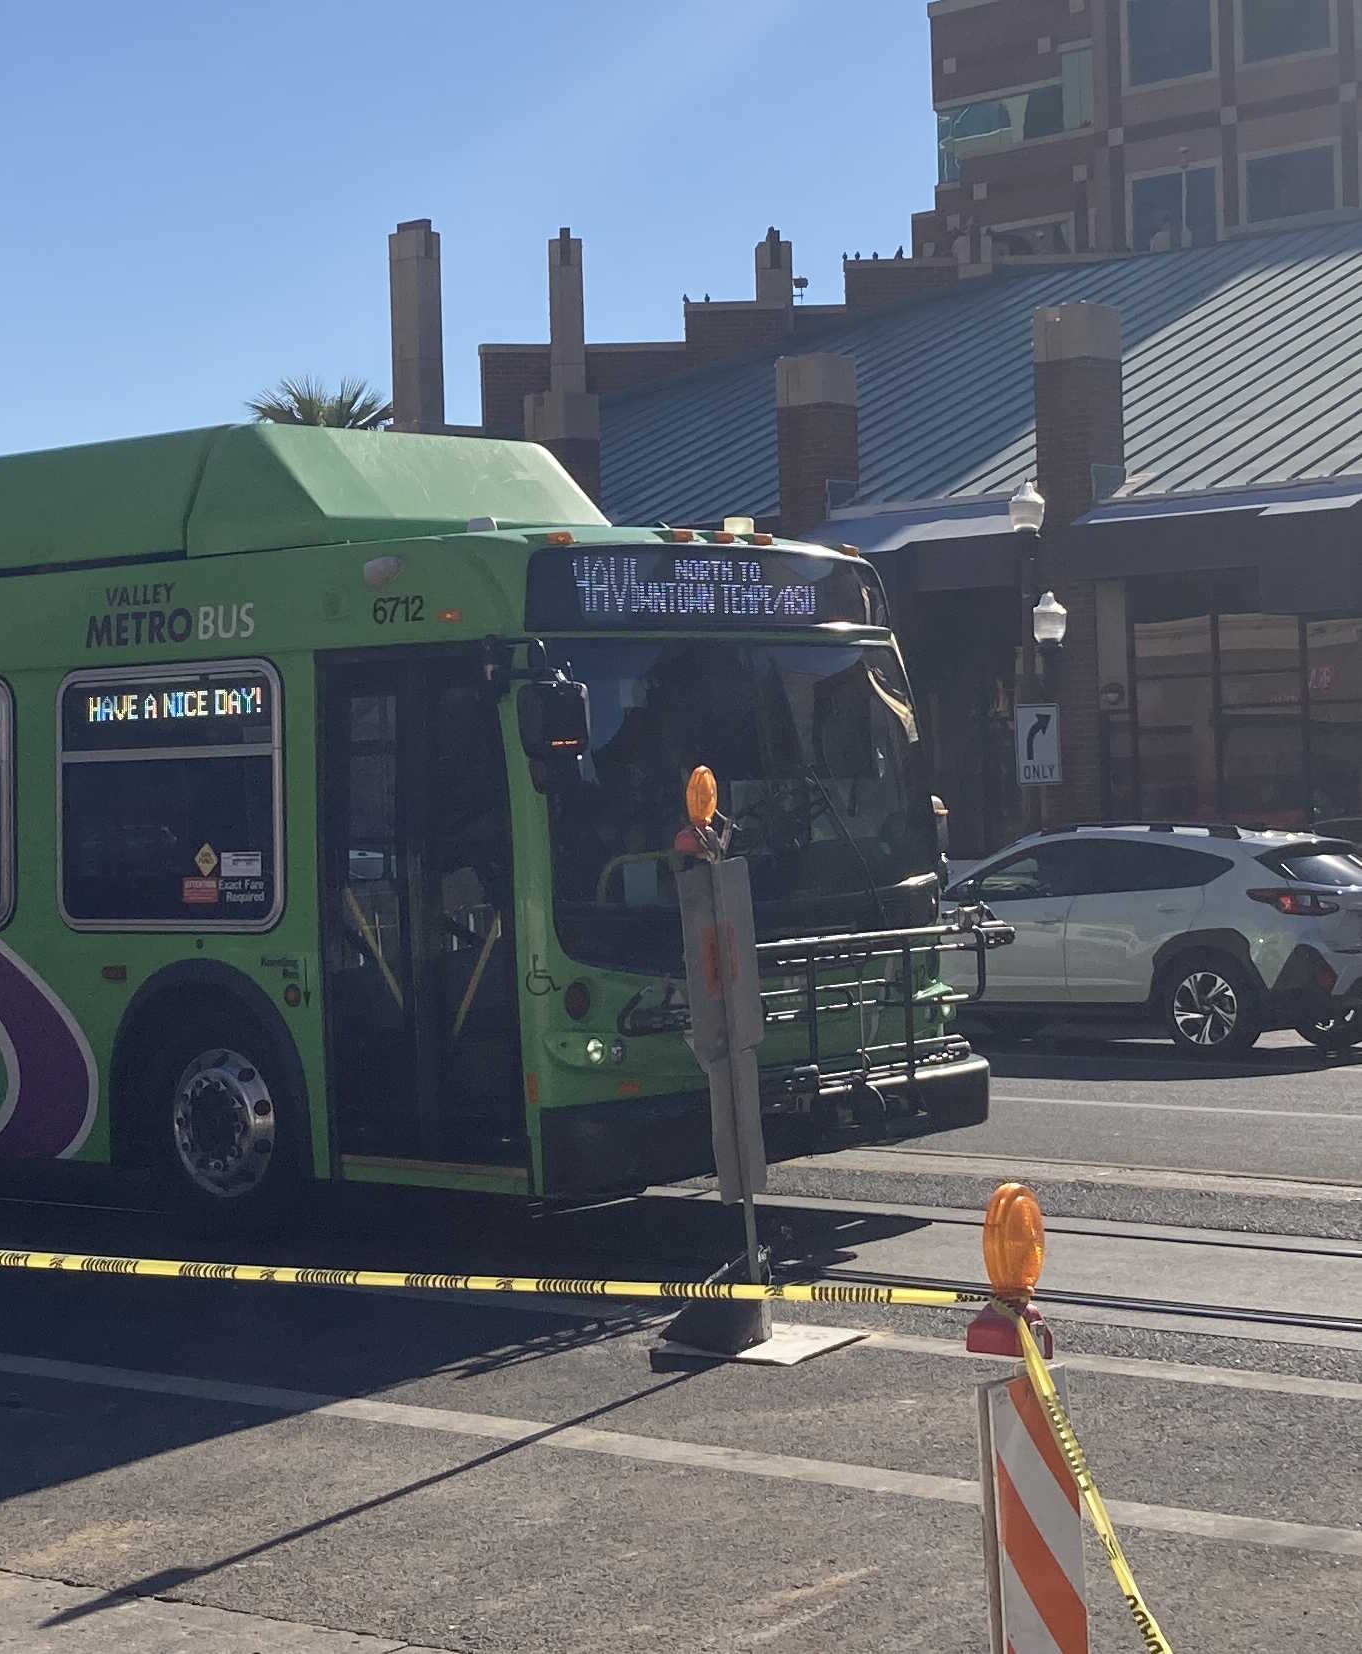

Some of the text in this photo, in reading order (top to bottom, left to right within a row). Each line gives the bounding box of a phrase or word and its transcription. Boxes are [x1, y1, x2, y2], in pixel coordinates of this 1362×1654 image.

[674, 559, 762, 583] NORTH TO
[105, 582, 177, 607] VALLEY
[373, 595, 425, 625] 6712
[87, 603, 255, 648] METRO BUS
[88, 686, 263, 722] HAVE A NICE DAY!
[1023, 765, 1056, 781] ONLY
[218, 879, 265, 890] Exact Fare
[226, 891, 265, 904] Required
